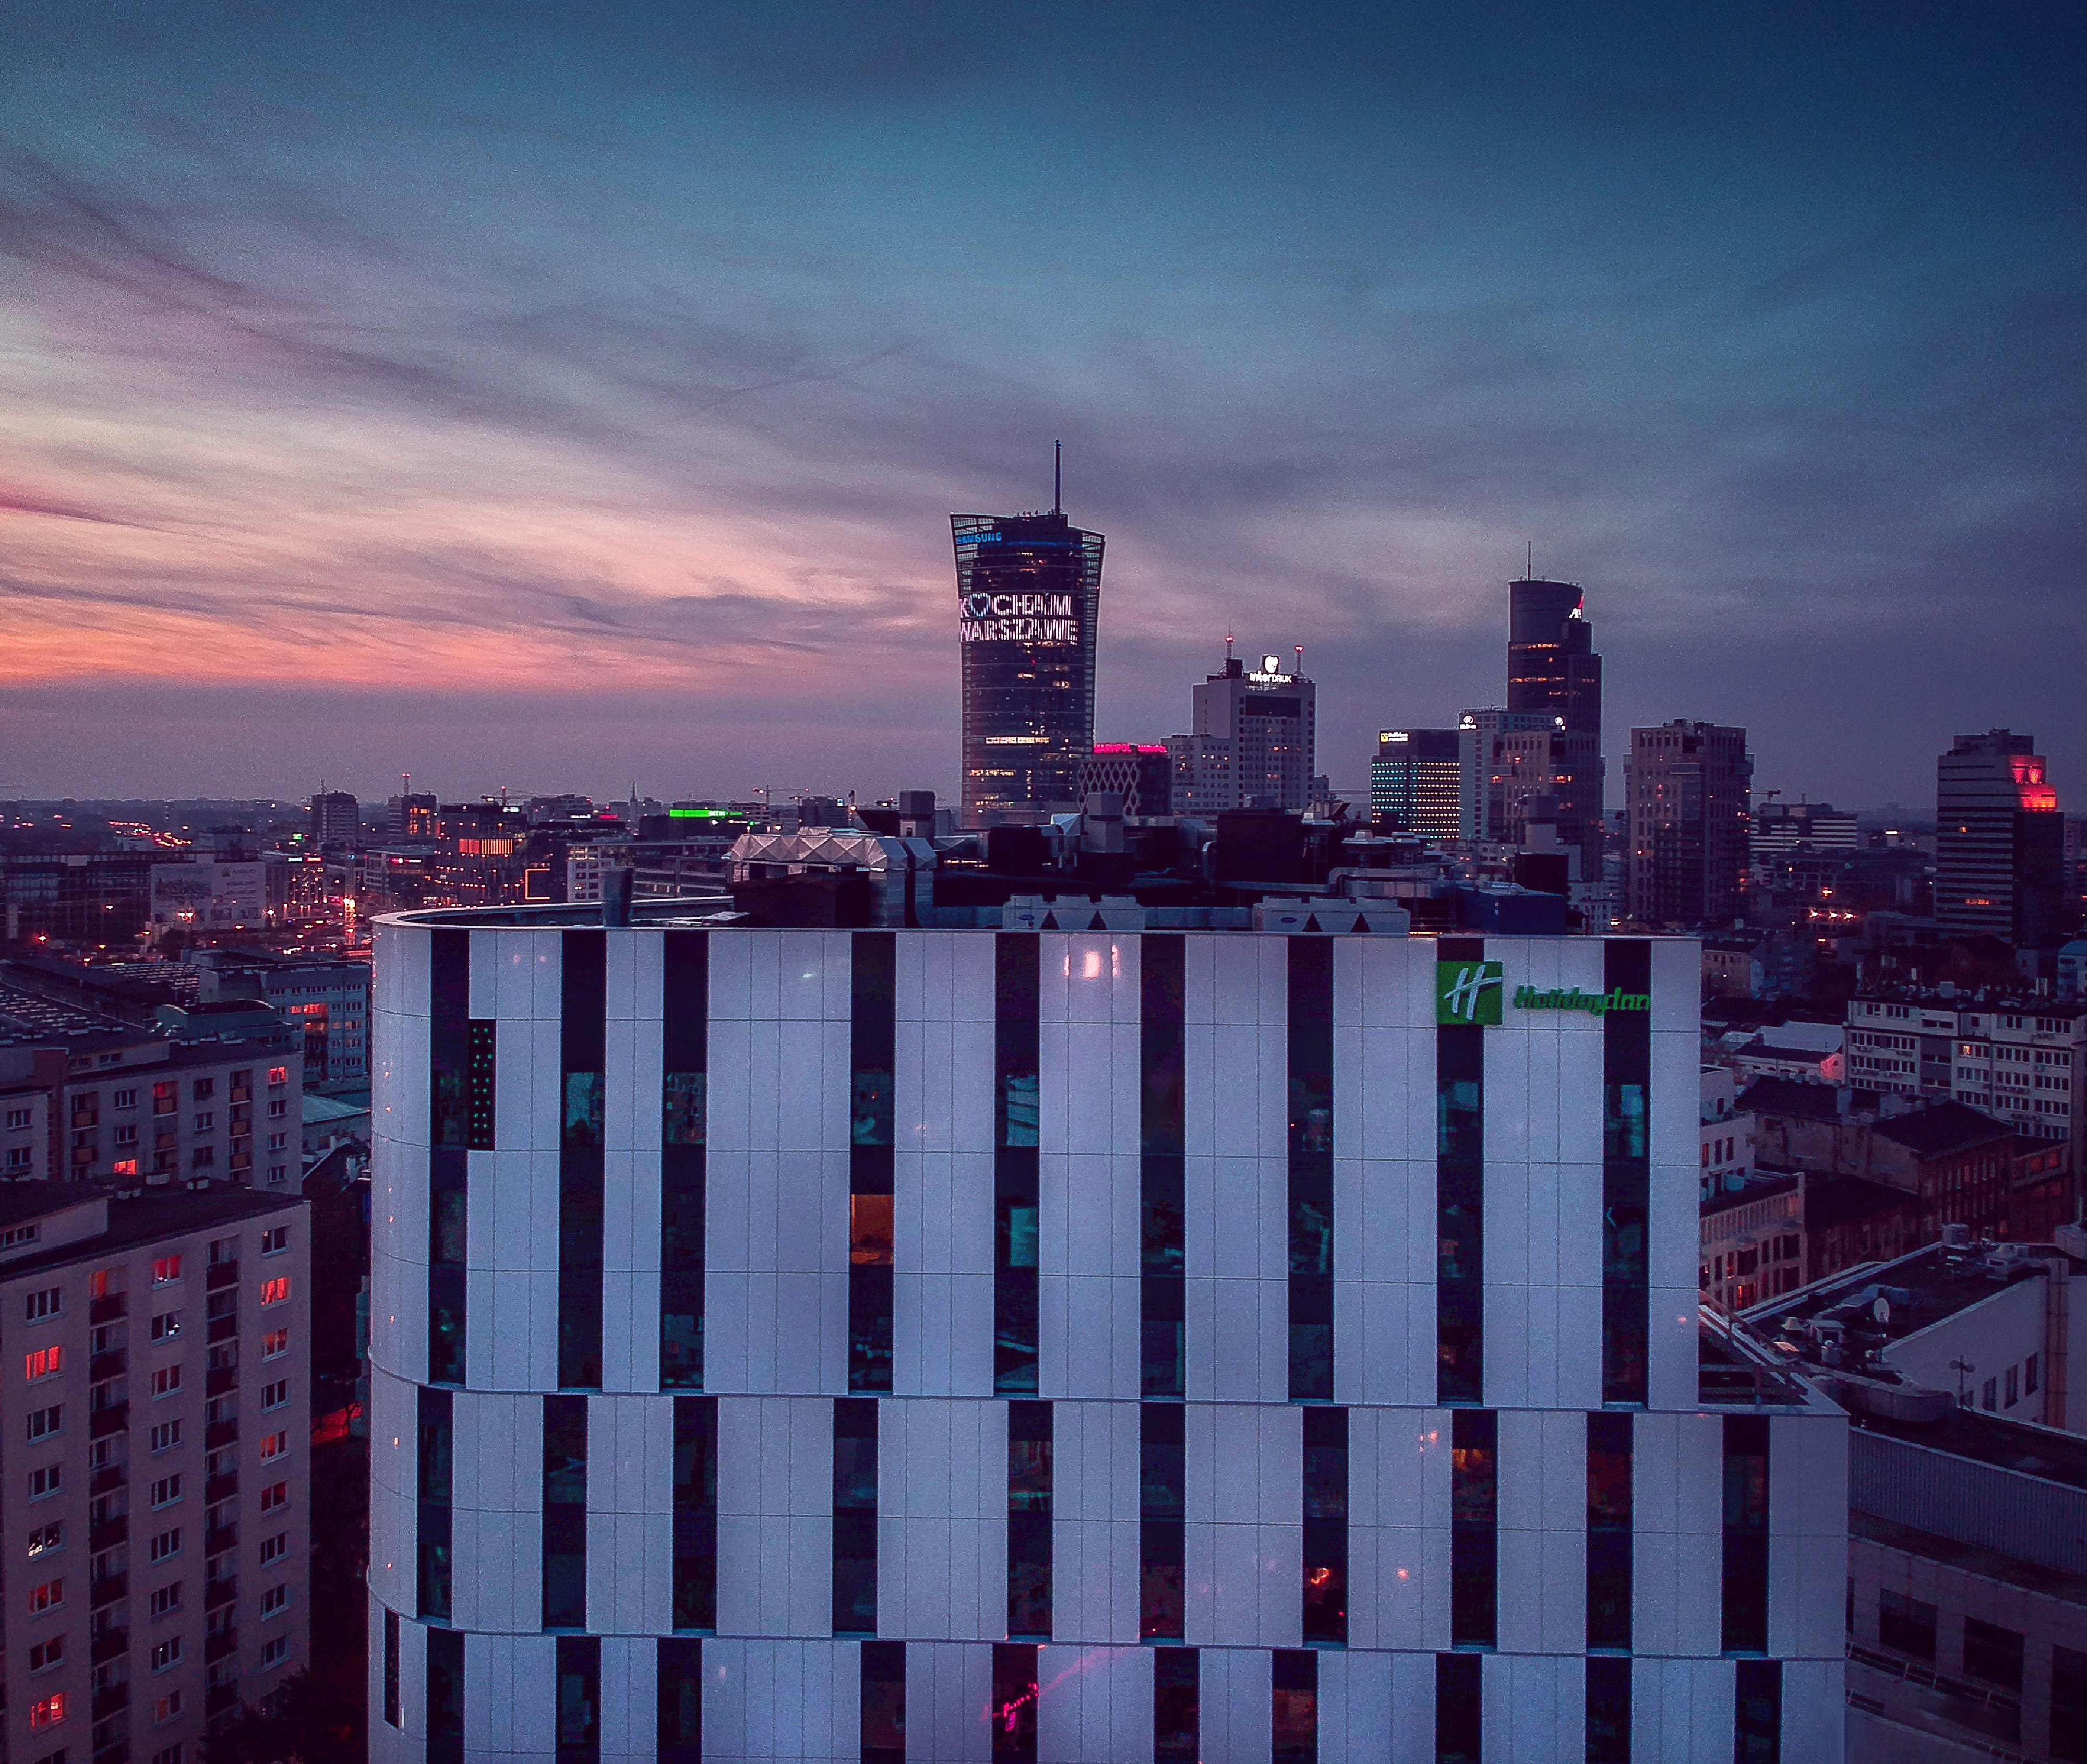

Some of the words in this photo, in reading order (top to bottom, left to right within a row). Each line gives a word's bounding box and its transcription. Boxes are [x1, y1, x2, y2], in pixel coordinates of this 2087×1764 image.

[957, 532, 1002, 544] SAMSUNG
[1514, 985, 1611, 1016] Holiday
[1612, 987, 1650, 1011] Inn
